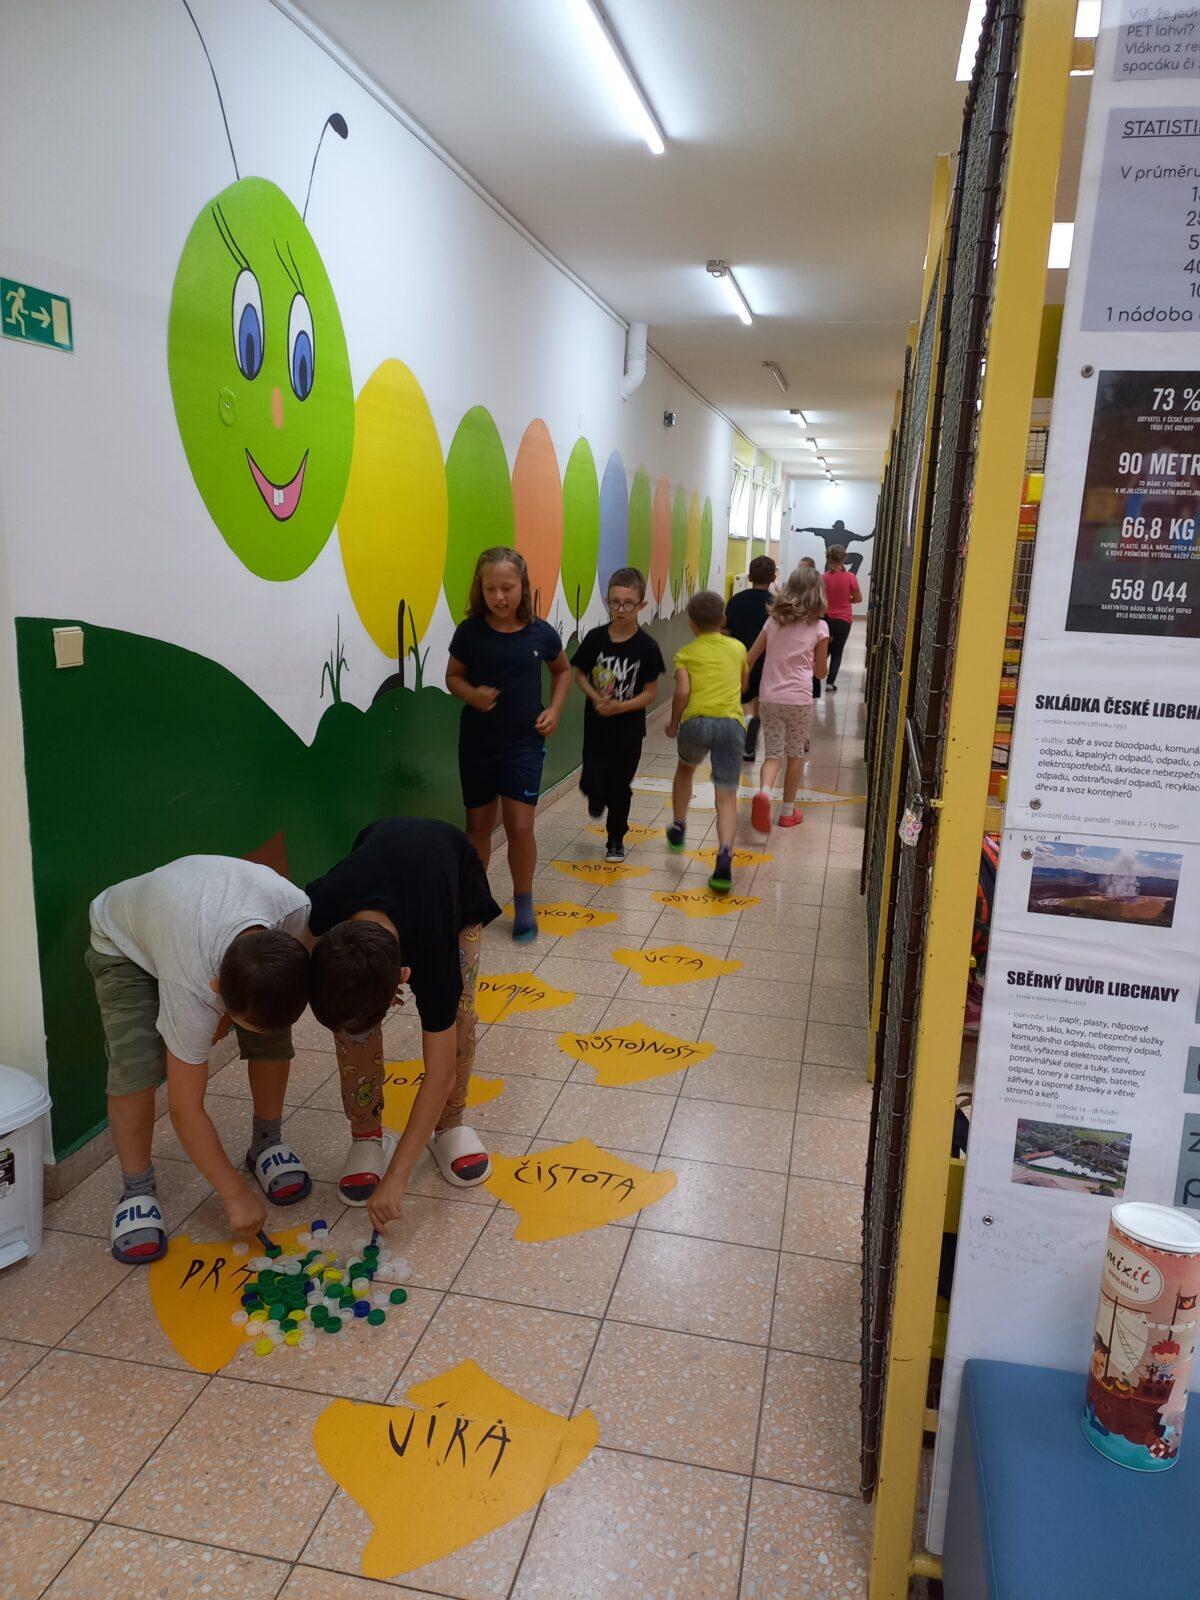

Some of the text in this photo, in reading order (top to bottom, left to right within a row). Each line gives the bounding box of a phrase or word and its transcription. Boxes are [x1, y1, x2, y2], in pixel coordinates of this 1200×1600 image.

[1127, 23, 1195, 38] PET lahví?
[1125, 42, 1170, 54] Vlákna
[1174, 44, 1181, 53] z
[1123, 57, 1195, 75] spacáku či
[1122, 119, 1200, 137] STATISTI
[1121, 166, 1132, 179] V
[1107, 306, 1193, 322] 1 nádoba
[1152, 387, 1200, 411] 73 %
[1118, 452, 1143, 475] 90
[1121, 516, 1195, 541] 66,8 KG
[1110, 578, 1188, 603] 558 044
[1035, 694, 1100, 714] SKLÁDKA
[1104, 696, 1150, 717] ČESKÉ
[1066, 737, 1085, 746] sběr
[1094, 740, 1113, 748] svoz
[1115, 740, 1163, 752] bioodpadu,
[1040, 748, 1073, 758] odpadu,
[1076, 750, 1117, 761] kapalných
[1119, 753, 1154, 764] odpadů,
[1156, 757, 1191, 767] odpadu,
[1038, 760, 1200, 780] elektrospotřebičů, likvidace nebezpečn
[1035, 783, 1058, 793] dřeva
[1066, 786, 1086, 795] svoz
[1087, 787, 1133, 798] kontejnerů
[1037, 772, 1200, 793] odpadu, odstraňování odpadů, recyklac
[571, 864, 631, 873] RADOST
[645, 951, 704, 970] ÚCTA
[478, 981, 546, 1003] DVAHA
[1007, 970, 1062, 990] SBĚRNÝ
[1064, 976, 1105, 995] DVŮR
[1107, 981, 1180, 1003] LIBCHAVY
[1012, 1021, 1165, 1047] kartóny, sklo, kovy, nebezpečné složky
[1059, 1015, 1082, 1026] papír,
[1083, 1018, 1110, 1030] plasty,
[1111, 1021, 1149, 1033] nápojové
[575, 1035, 704, 1060] DŮSTOJNOST
[1010, 1043, 1130, 1065] textil, vyřazená elektrozařízení,
[1011, 1032, 1162, 1058] komunálního odpadu, objemný odpad,
[1008, 1065, 1035, 1076] odpad,
[1037, 1068, 1063, 1080] tonery
[1070, 1072, 1108, 1086] cartridge,
[1109, 1078, 1140, 1088] baterie,
[1009, 1054, 1062, 1067] potravinářské
[1063, 1060, 1082, 1071] oleje
[1090, 1064, 1109, 1074] tuky,
[1111, 1066, 1146, 1077] stavební
[1006, 1085, 1034, 1096] stromů
[1041, 1090, 1059, 1100] keřů
[1007, 1075, 1034, 1087] zářivky
[1041, 1080, 1073, 1091] úsporné
[1075, 1084, 1105, 1096] žárovky
[1113, 1088, 1135, 1098] větve
[260, 1151, 301, 1176] FILA
[513, 1160, 636, 1203] ČISTOTA
[115, 1204, 162, 1229] FILA
[388, 1400, 512, 1479] VÍRA
